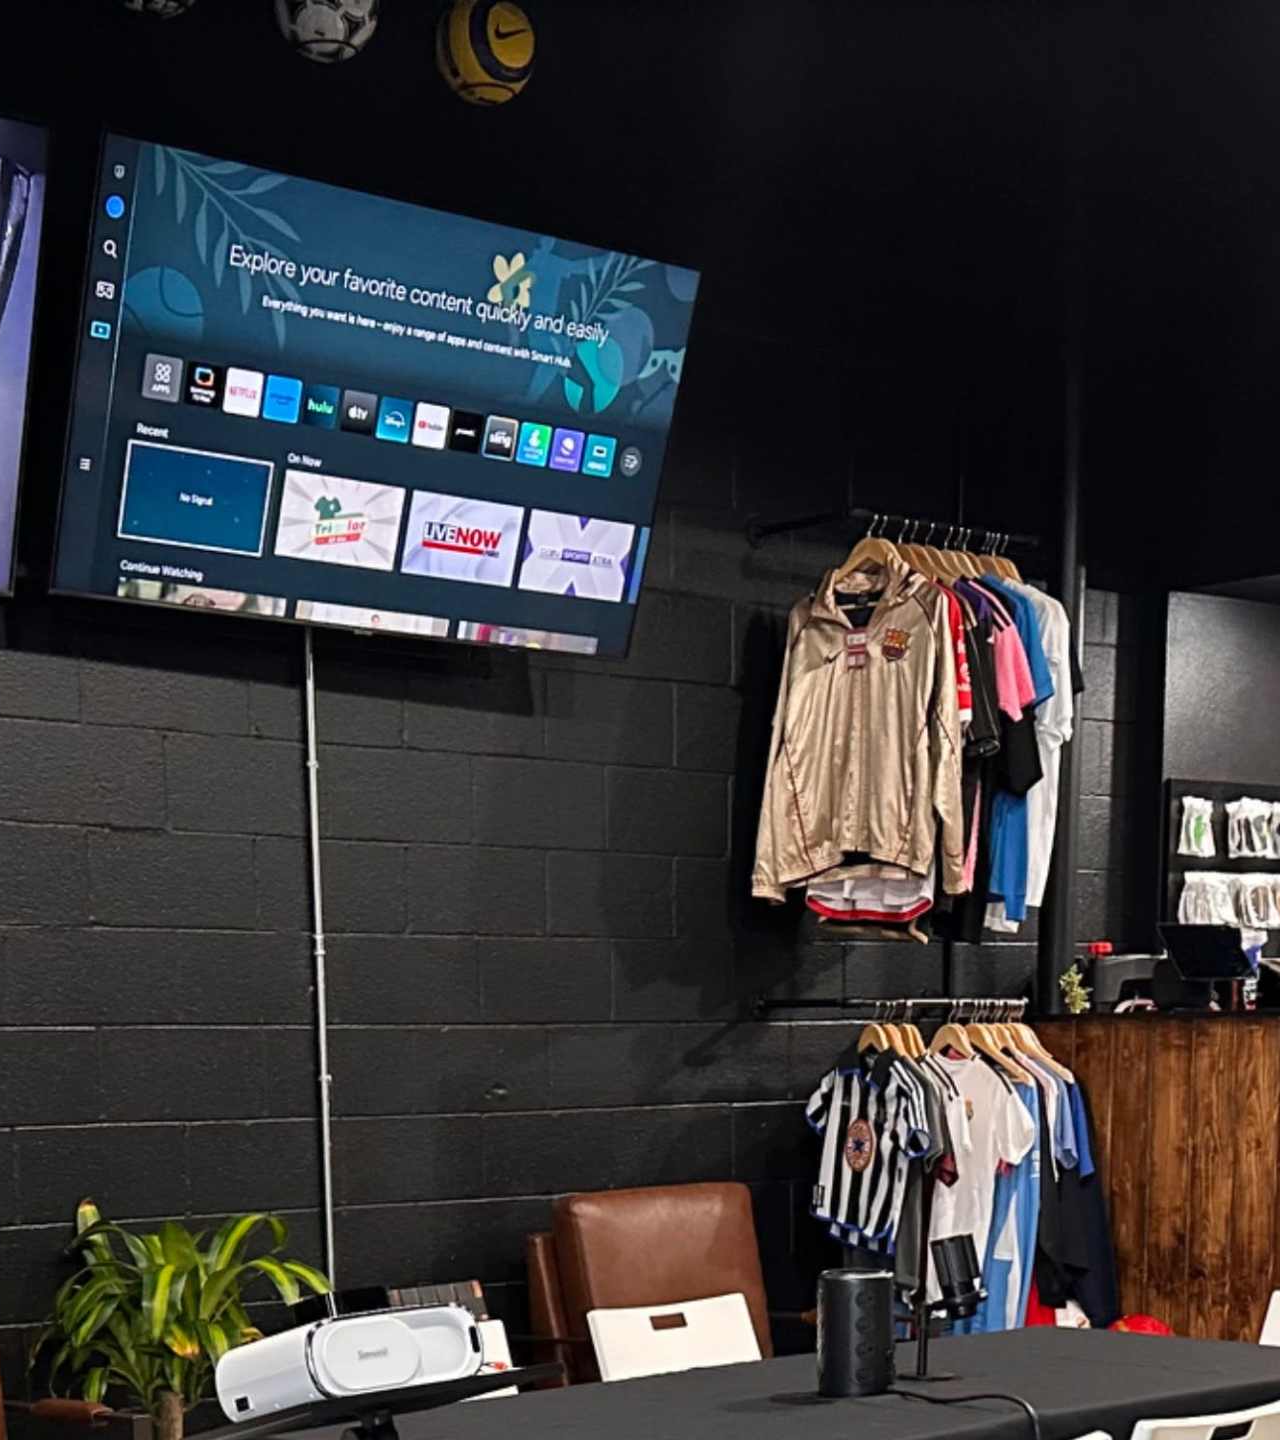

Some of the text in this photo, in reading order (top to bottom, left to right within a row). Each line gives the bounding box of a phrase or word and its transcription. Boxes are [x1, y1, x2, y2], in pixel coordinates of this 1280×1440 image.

[229, 244, 609, 348] Explore your favorite content quickly and easily
[262, 295, 308, 317] Everything
[307, 398, 334, 415] hulu
[136, 423, 169, 438] Recent
[287, 452, 301, 464] On
[120, 559, 204, 582] Continue Watching
